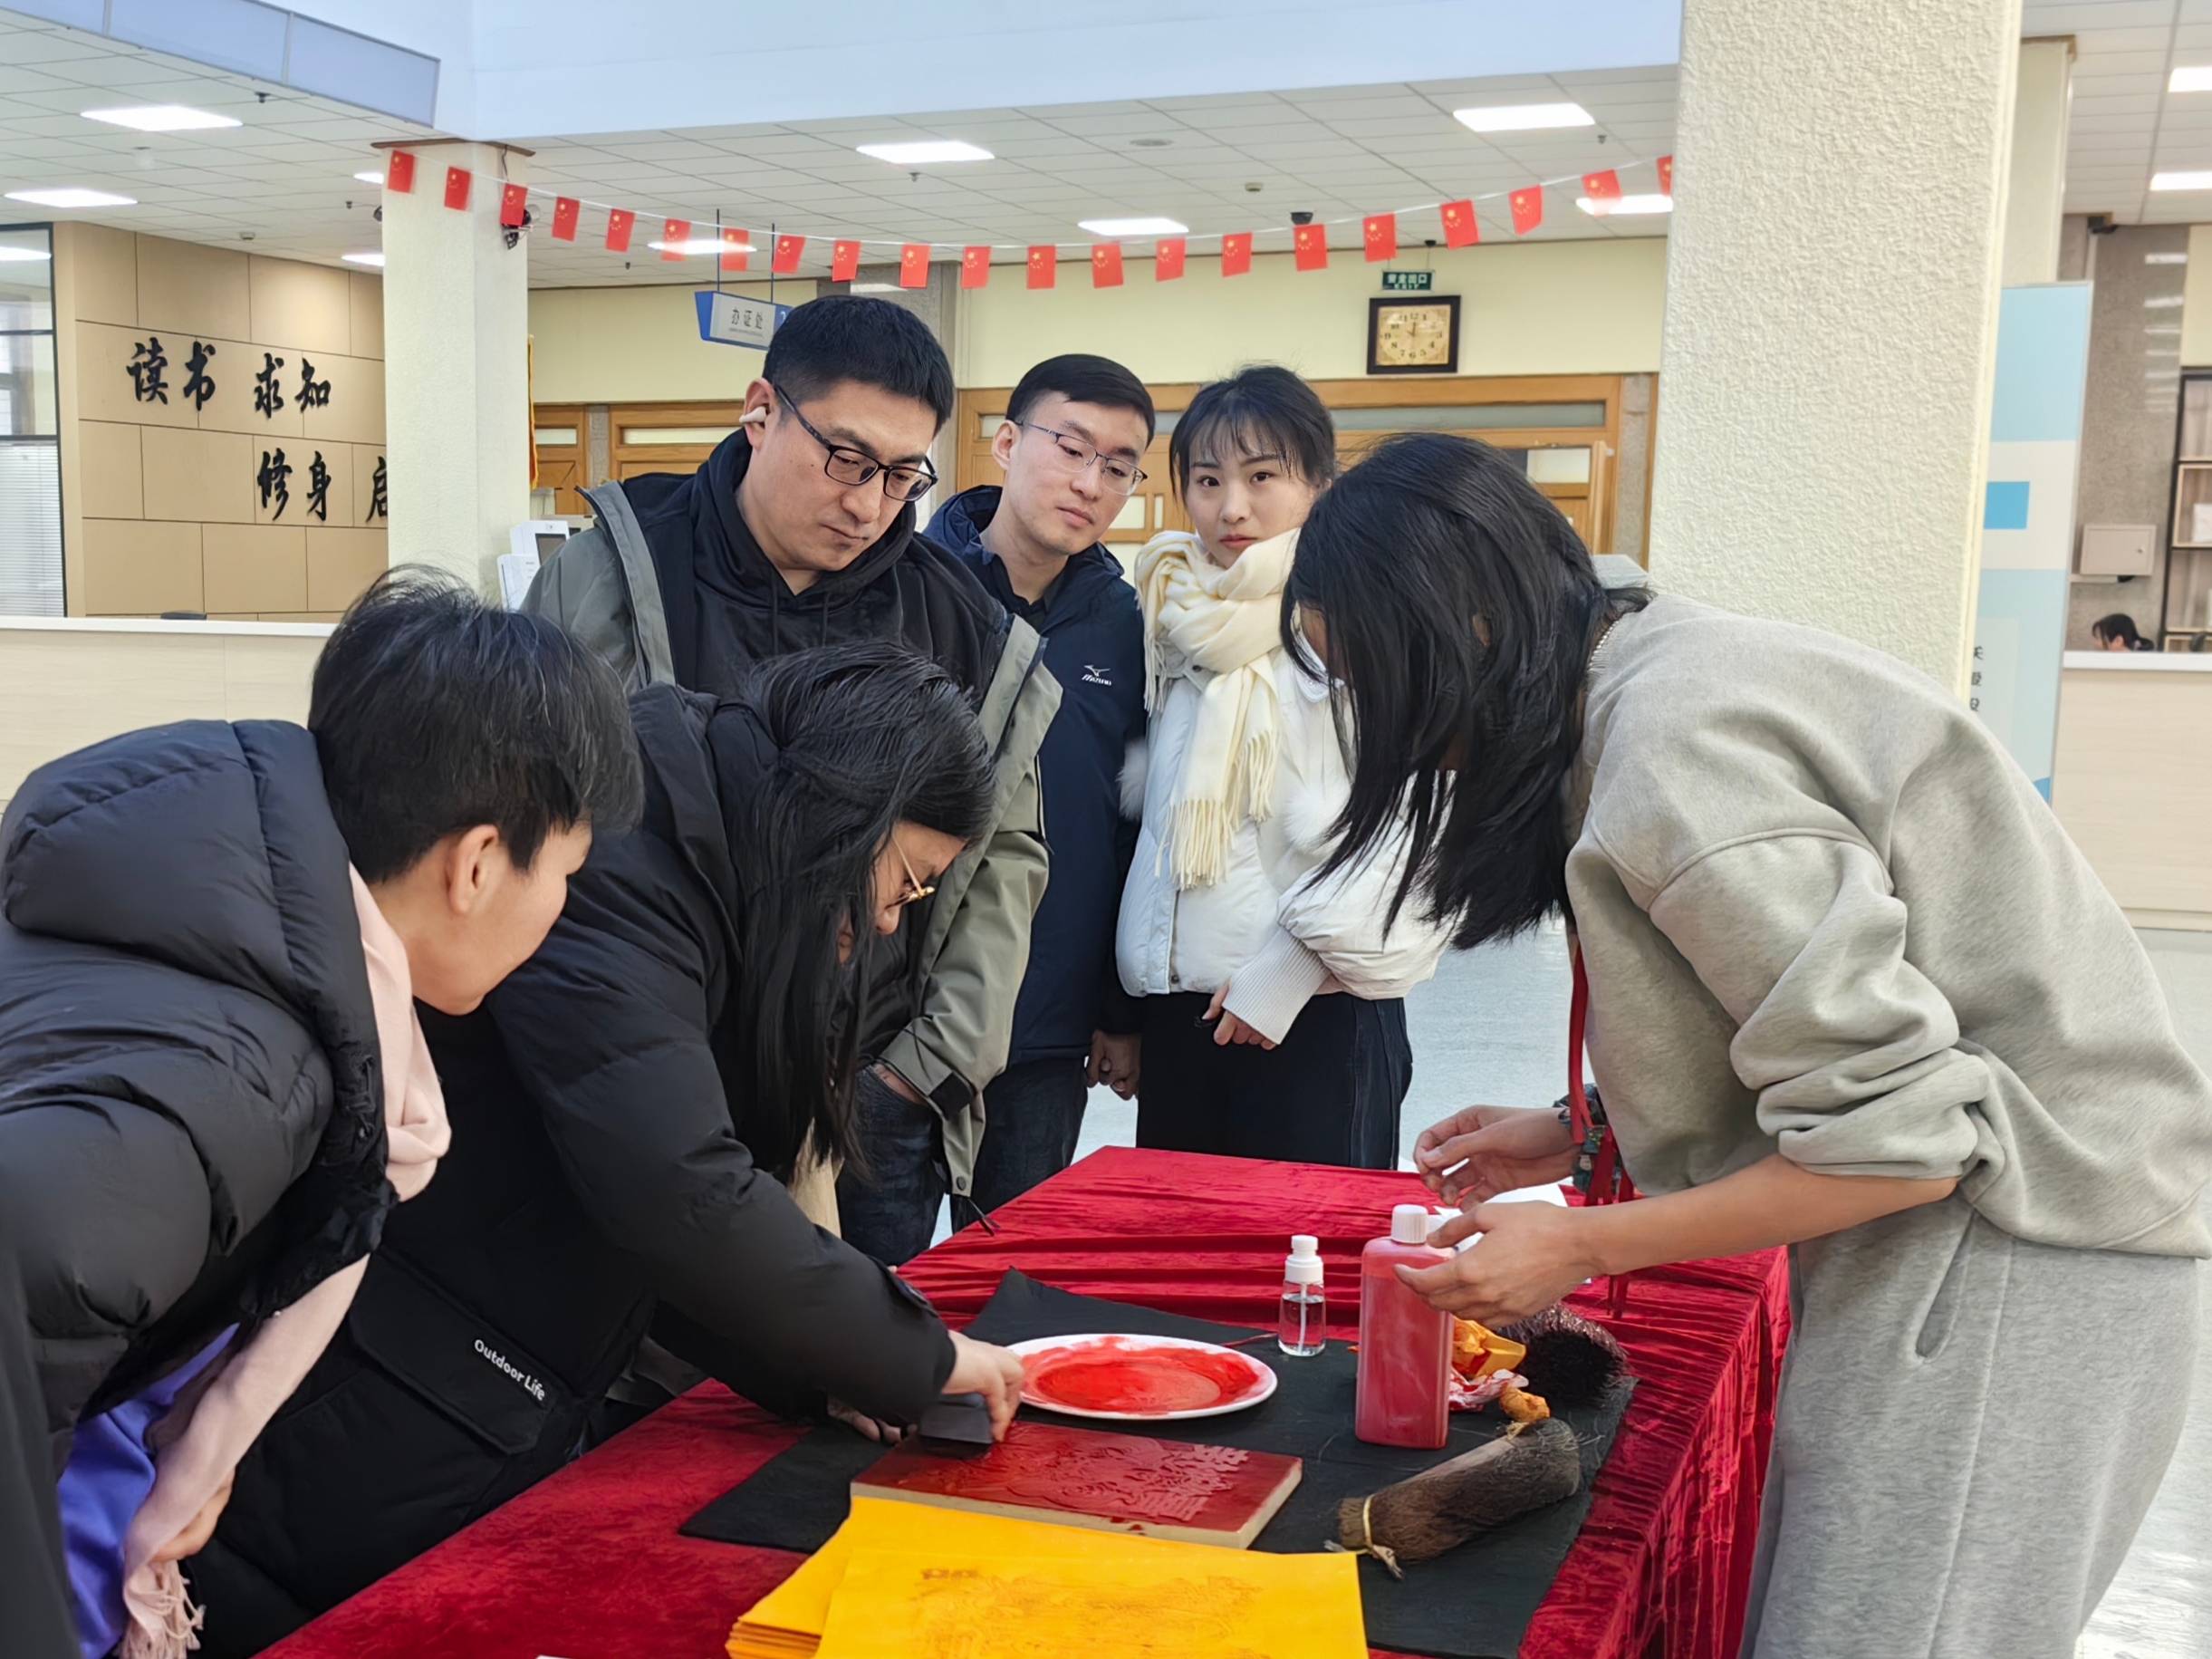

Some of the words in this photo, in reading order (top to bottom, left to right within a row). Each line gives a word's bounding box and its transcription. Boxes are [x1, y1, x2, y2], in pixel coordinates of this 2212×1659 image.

[731, 307, 764, 330] 办证处
[126, 336, 216, 411] 读书
[254, 352, 332, 419] 求知
[257, 448, 332, 521] 修身
[474, 1339, 525, 1383] Outdoor
[524, 1374, 545, 1402] Life
